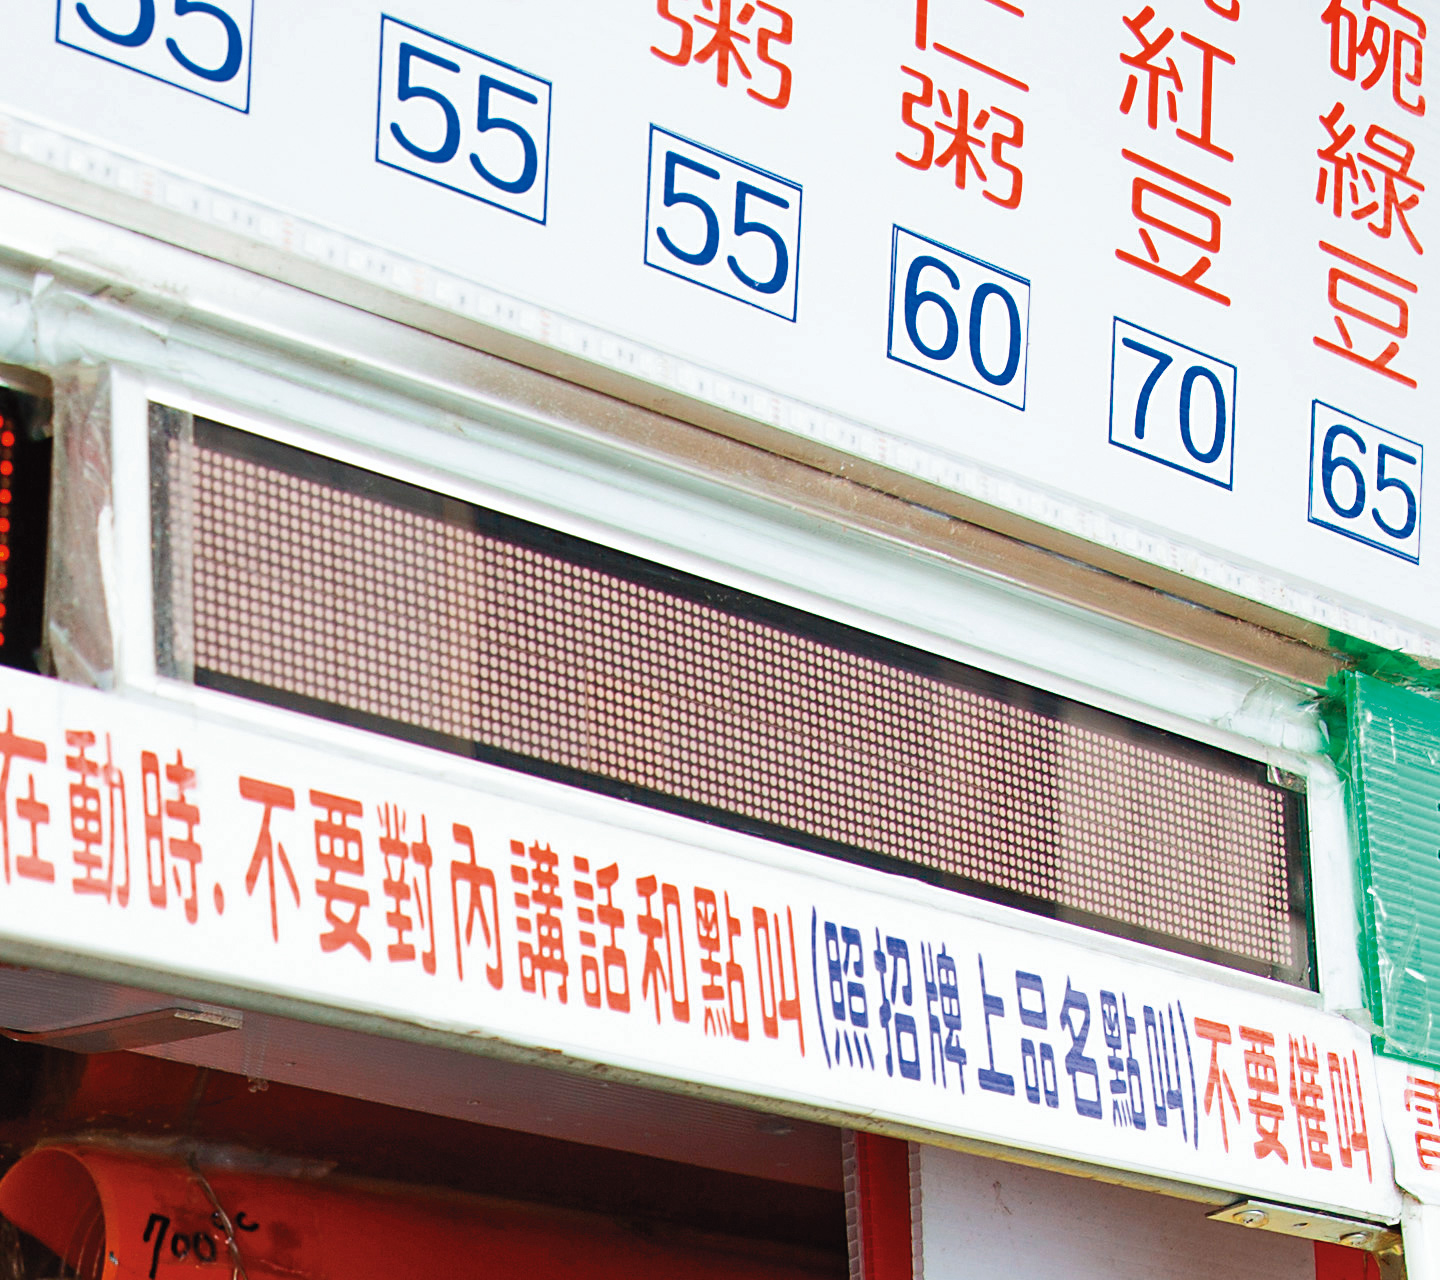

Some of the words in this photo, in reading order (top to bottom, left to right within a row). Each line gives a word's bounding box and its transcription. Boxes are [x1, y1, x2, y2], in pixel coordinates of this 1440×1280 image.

[389, 41, 541, 196] 55
[1114, 0, 1236, 307] 紅豆
[654, 150, 791, 298] 55
[903, 255, 1024, 388] 60
[1120, 336, 1227, 466] 70
[1320, 423, 1418, 542] 65
